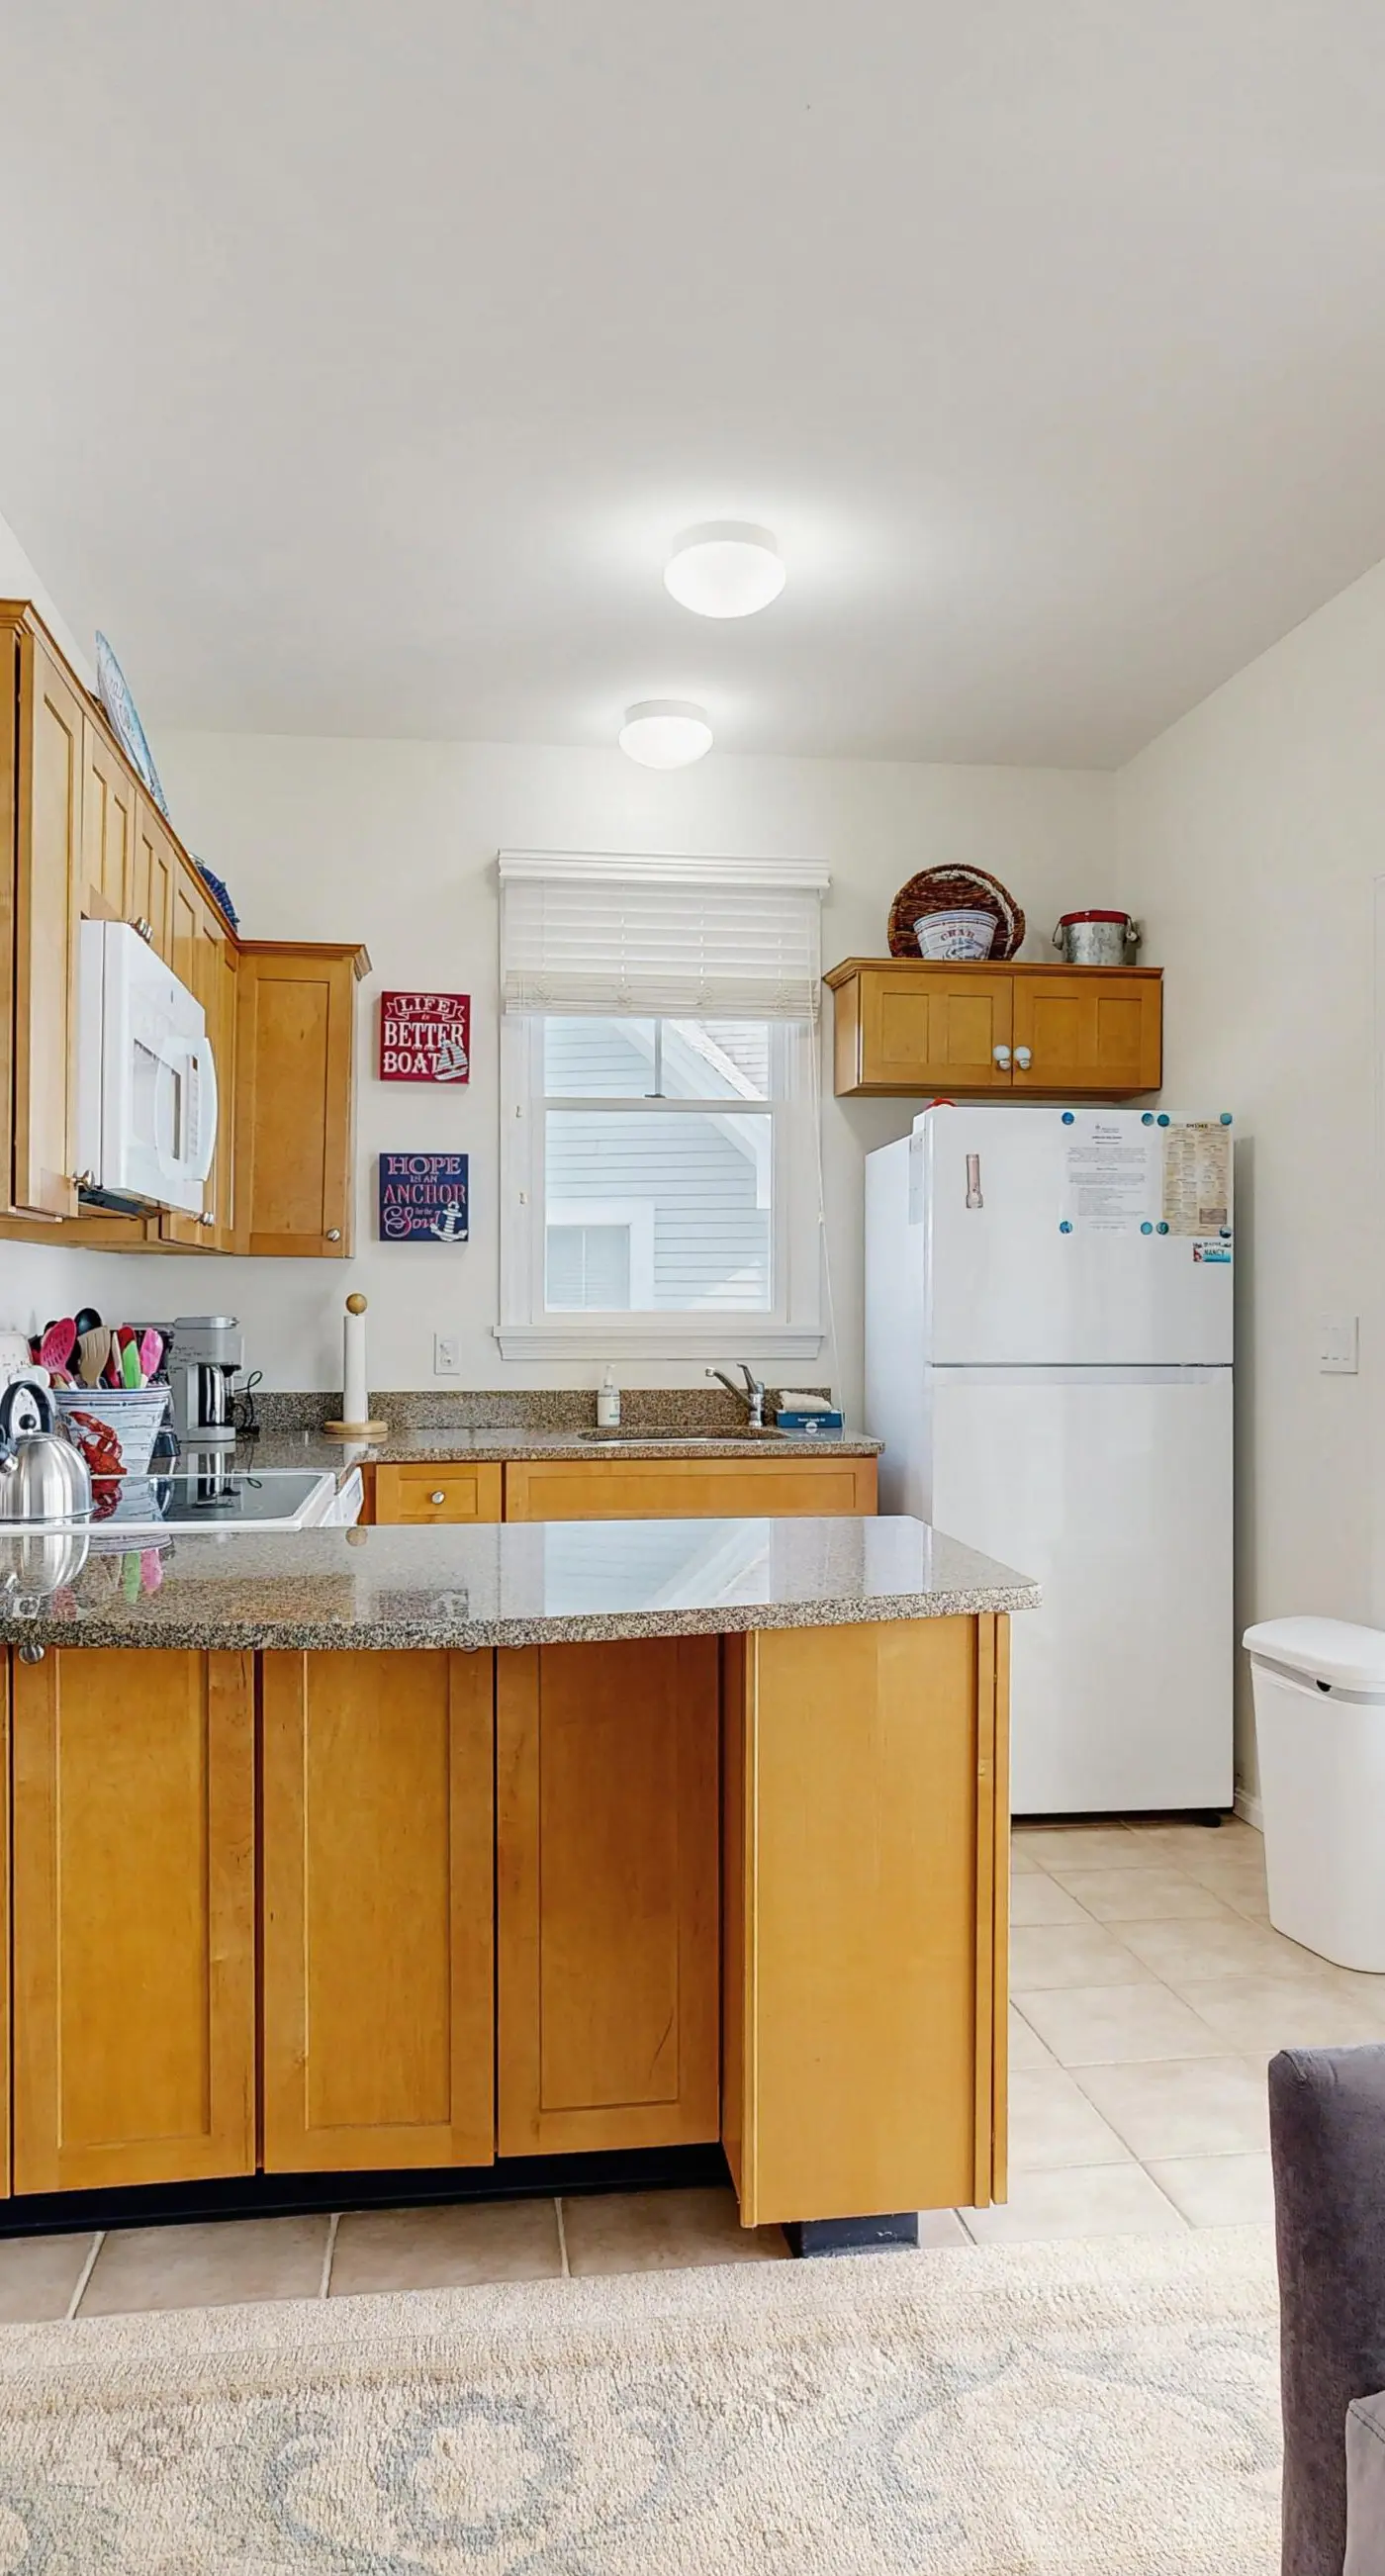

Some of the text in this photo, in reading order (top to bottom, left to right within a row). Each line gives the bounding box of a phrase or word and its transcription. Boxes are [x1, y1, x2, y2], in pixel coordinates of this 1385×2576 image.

[400, 997, 451, 1014] LIFE
[384, 1021, 464, 1049] BETTER
[383, 1051, 441, 1074] BOAT
[387, 1156, 462, 1175] HOPE
[423, 1174, 437, 1183] AN
[384, 1184, 466, 1204] ANCHOR
